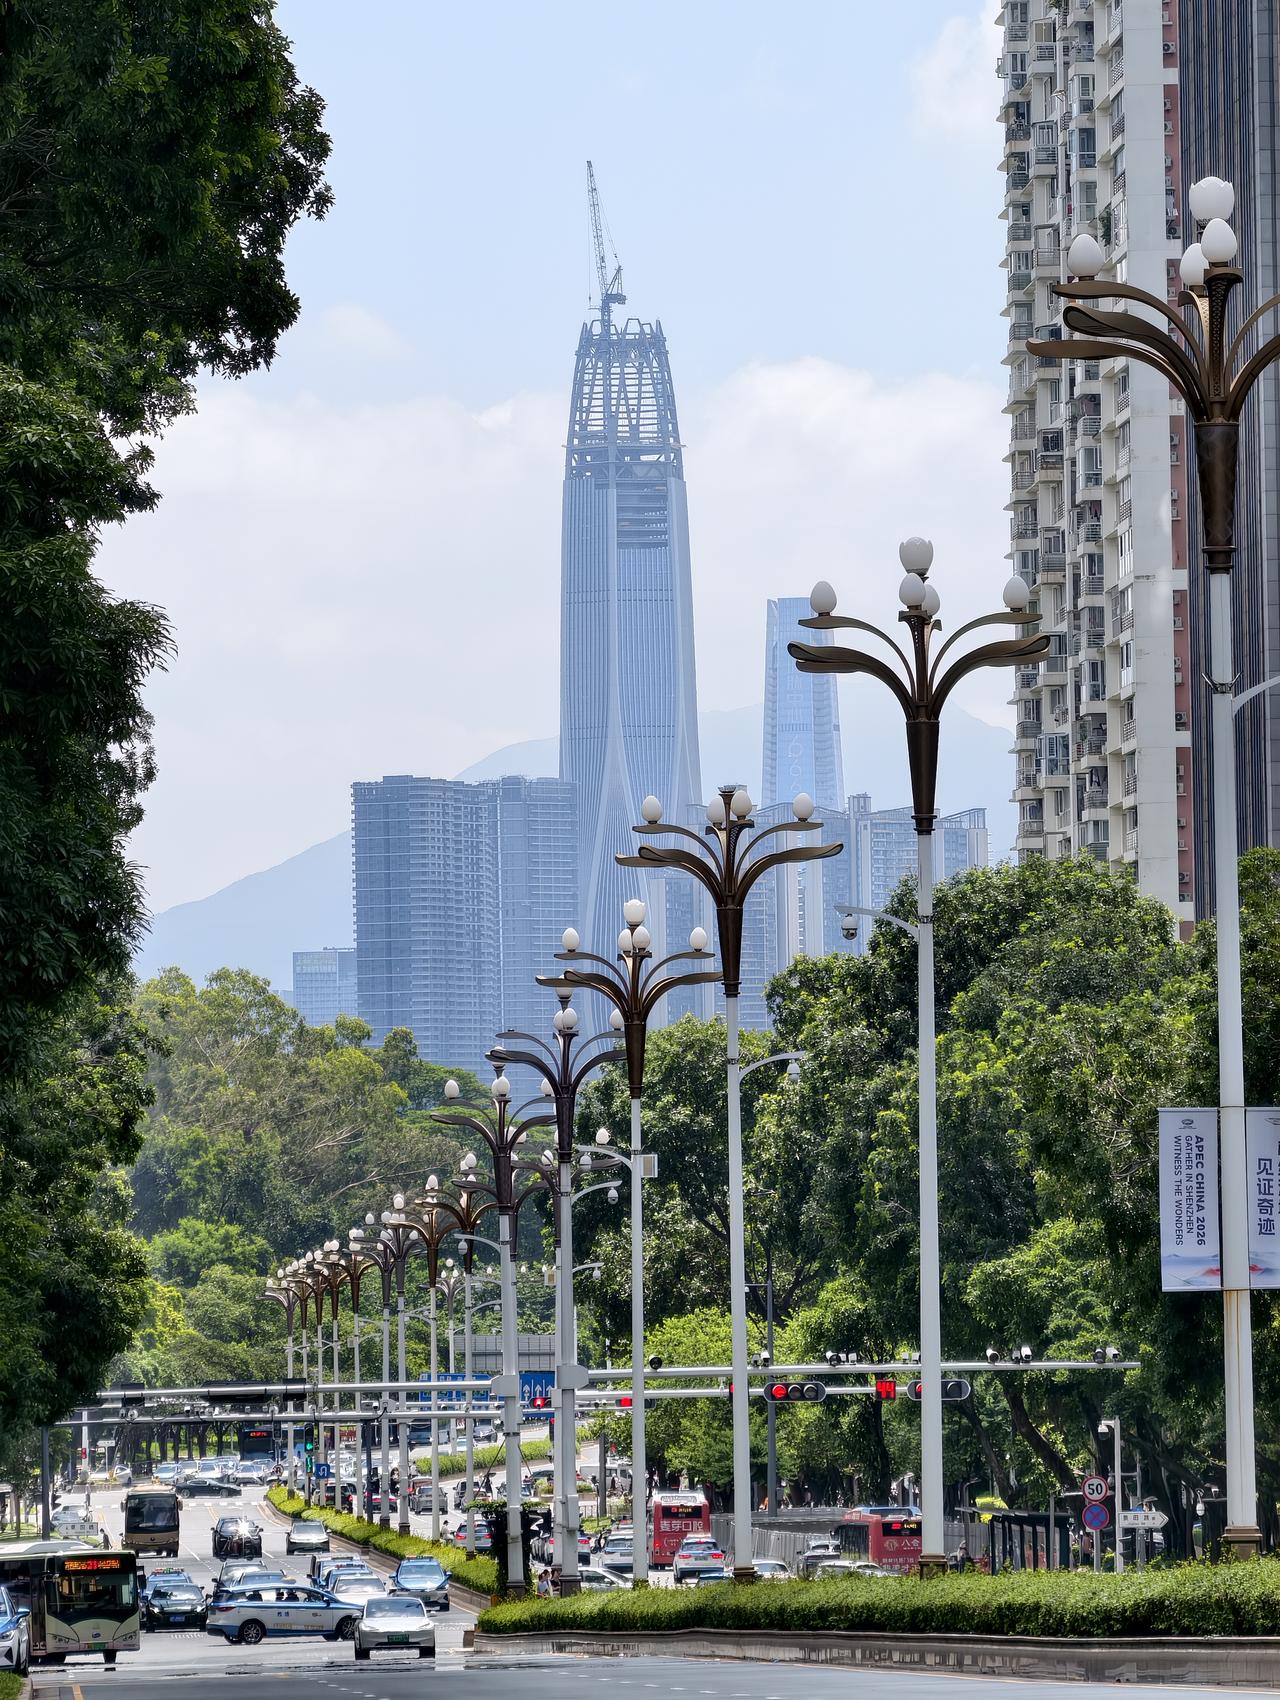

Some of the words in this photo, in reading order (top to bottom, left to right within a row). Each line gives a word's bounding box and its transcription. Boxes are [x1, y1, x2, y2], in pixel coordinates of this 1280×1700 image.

[1174, 1135, 1182, 1176] WITNESS
[1185, 1135, 1193, 1171] GATHER
[1195, 1135, 1204, 1169] APEC
[1174, 1179, 1182, 1197] THE
[1185, 1174, 1193, 1183] IN
[1195, 1173, 1205, 1213] CHINA
[1186, 1185, 1194, 1234] SHENZHEN
[1256, 1157, 1276, 1236] 见证奇迹
[1175, 1199, 1183, 1246] WONDERS
[1196, 1217, 1206, 1246] 2026
[1087, 1483, 1103, 1496] 50
[660, 1520, 704, 1532] 麦芽口腔
